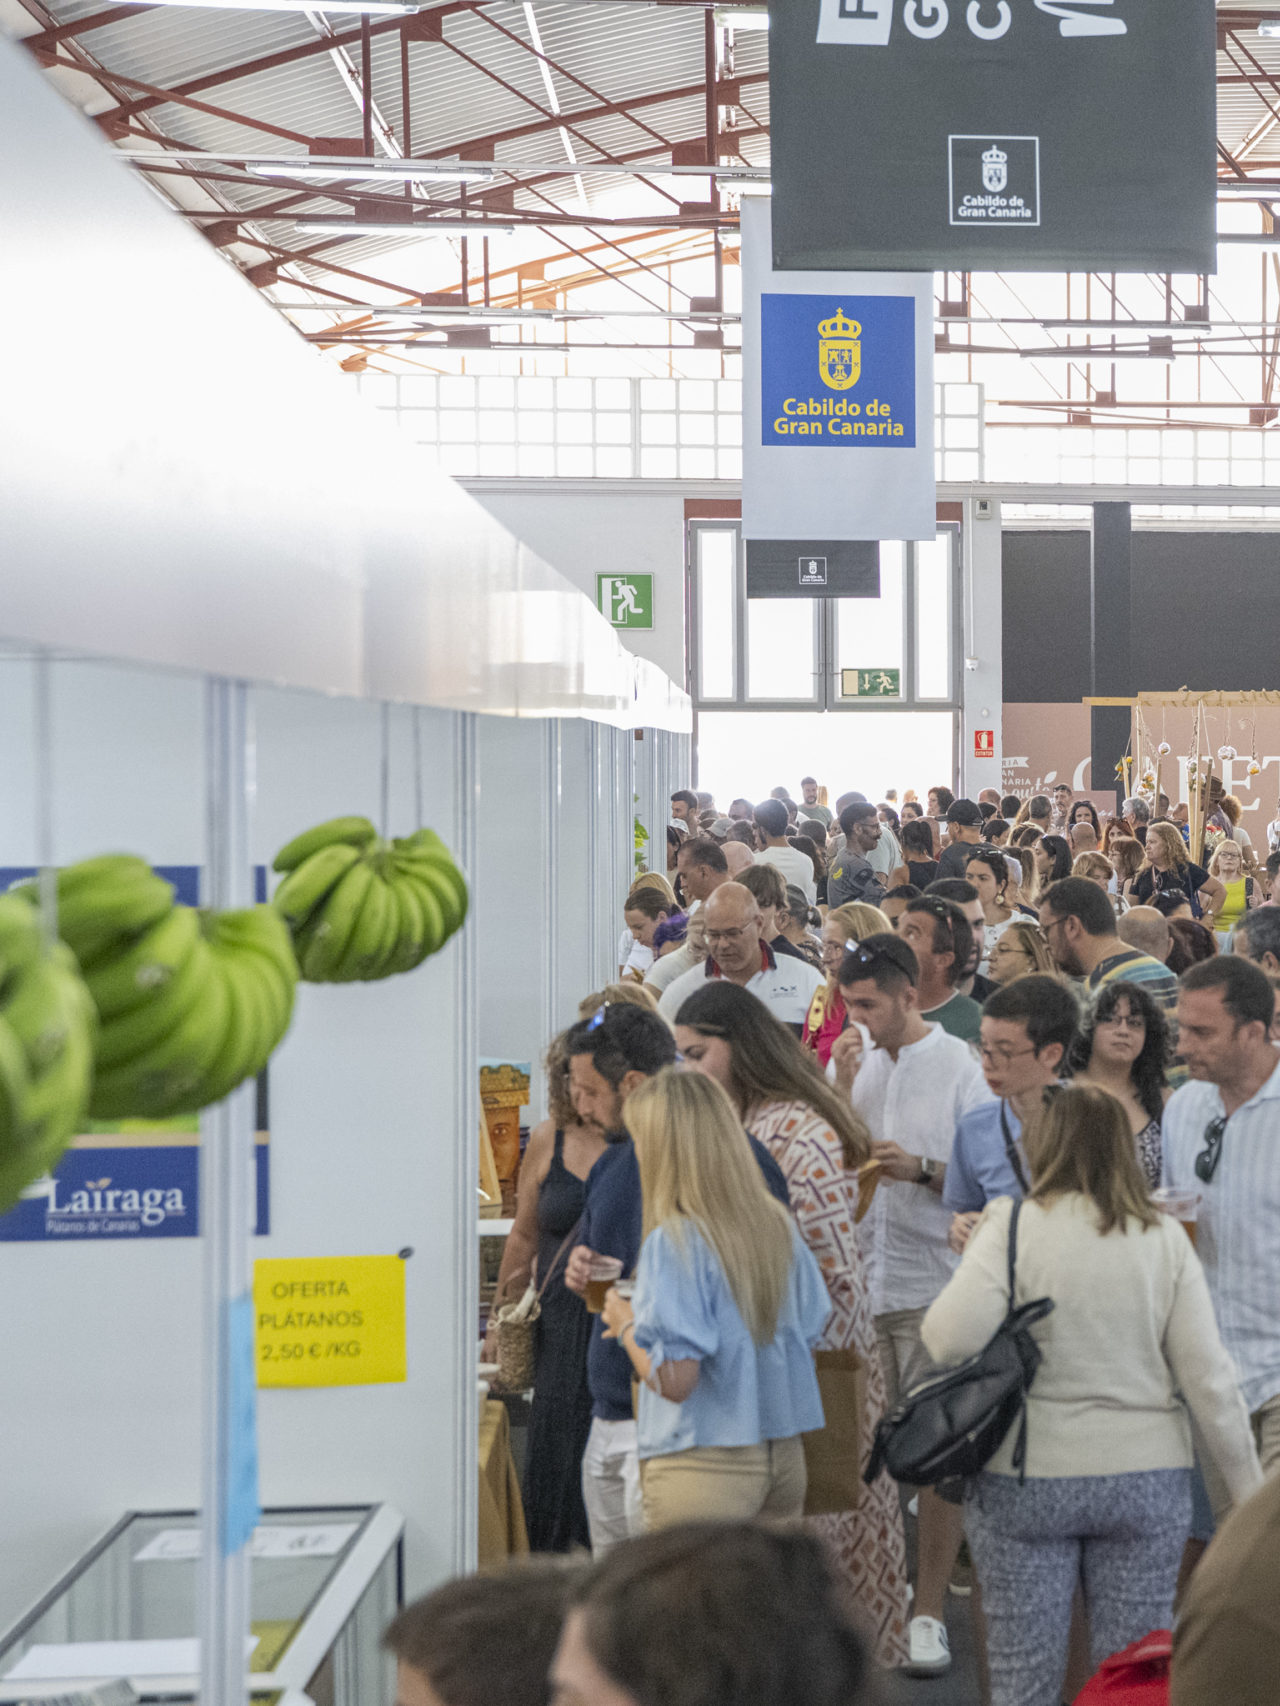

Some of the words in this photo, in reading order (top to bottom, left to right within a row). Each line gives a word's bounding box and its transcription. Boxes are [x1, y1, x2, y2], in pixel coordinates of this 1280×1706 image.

[963, 195, 1007, 206] Cabildo
[1009, 195, 1024, 206] de
[958, 206, 986, 217] Gran
[988, 206, 1032, 218] Canaria
[783, 398, 861, 416] Cabildo
[865, 399, 891, 416] de
[774, 417, 822, 434] Gran
[828, 418, 904, 436] Canaria
[272, 1280, 350, 1299] OFERTA
[258, 1307, 365, 1330] PLÁTANOS
[261, 1343, 304, 1362] 2,50
[309, 1342, 322, 1358] €
[326, 1340, 361, 1358] /KG
